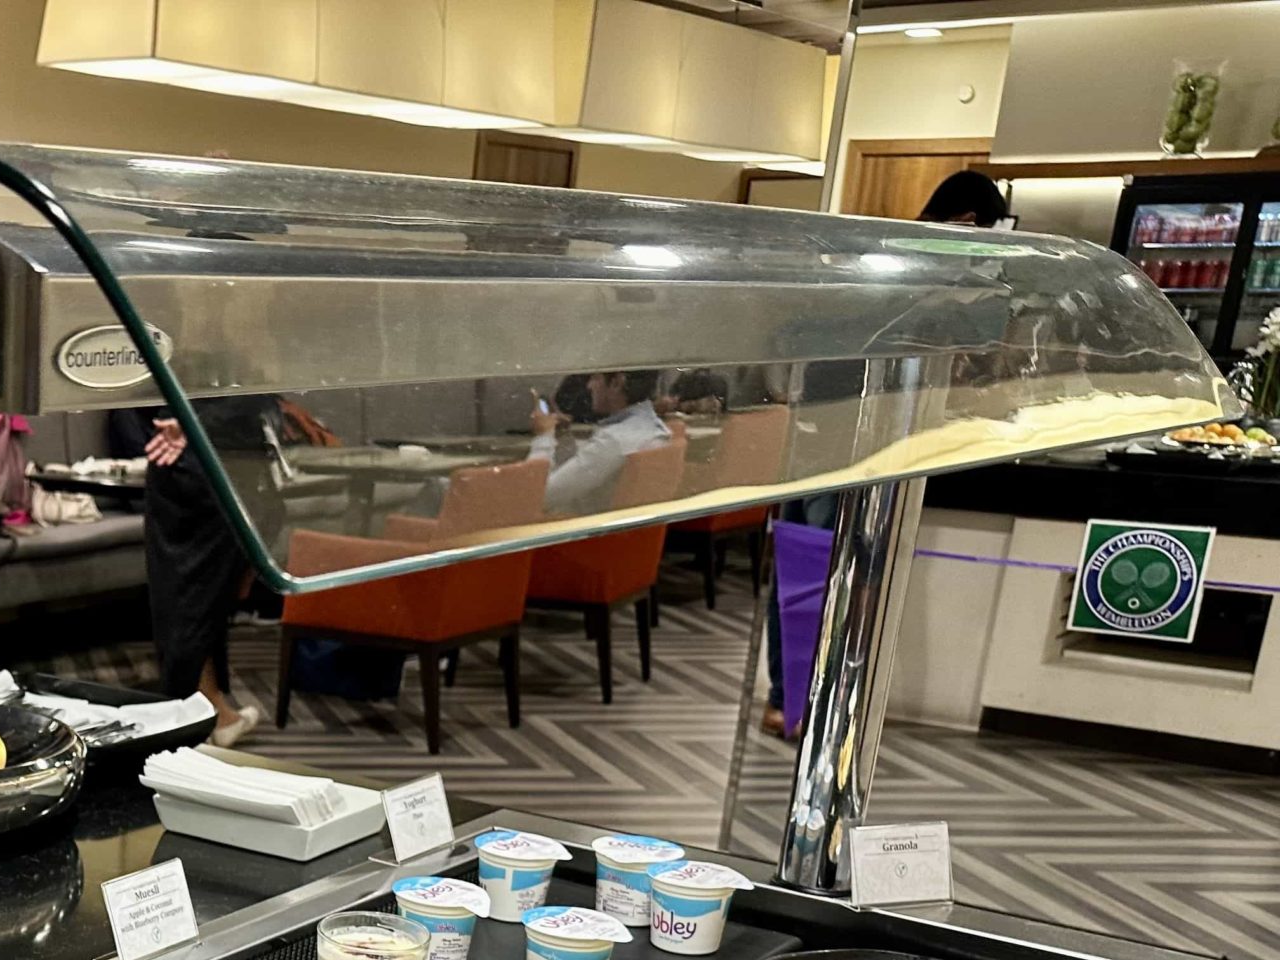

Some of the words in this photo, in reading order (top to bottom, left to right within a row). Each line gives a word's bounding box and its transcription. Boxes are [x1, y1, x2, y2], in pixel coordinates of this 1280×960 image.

[1109, 533, 1193, 581] CHAMPIONSHIPS
[1096, 602, 1171, 629] WIMBLEDON
[882, 841, 918, 852] Granola
[653, 911, 697, 939] Ubley
